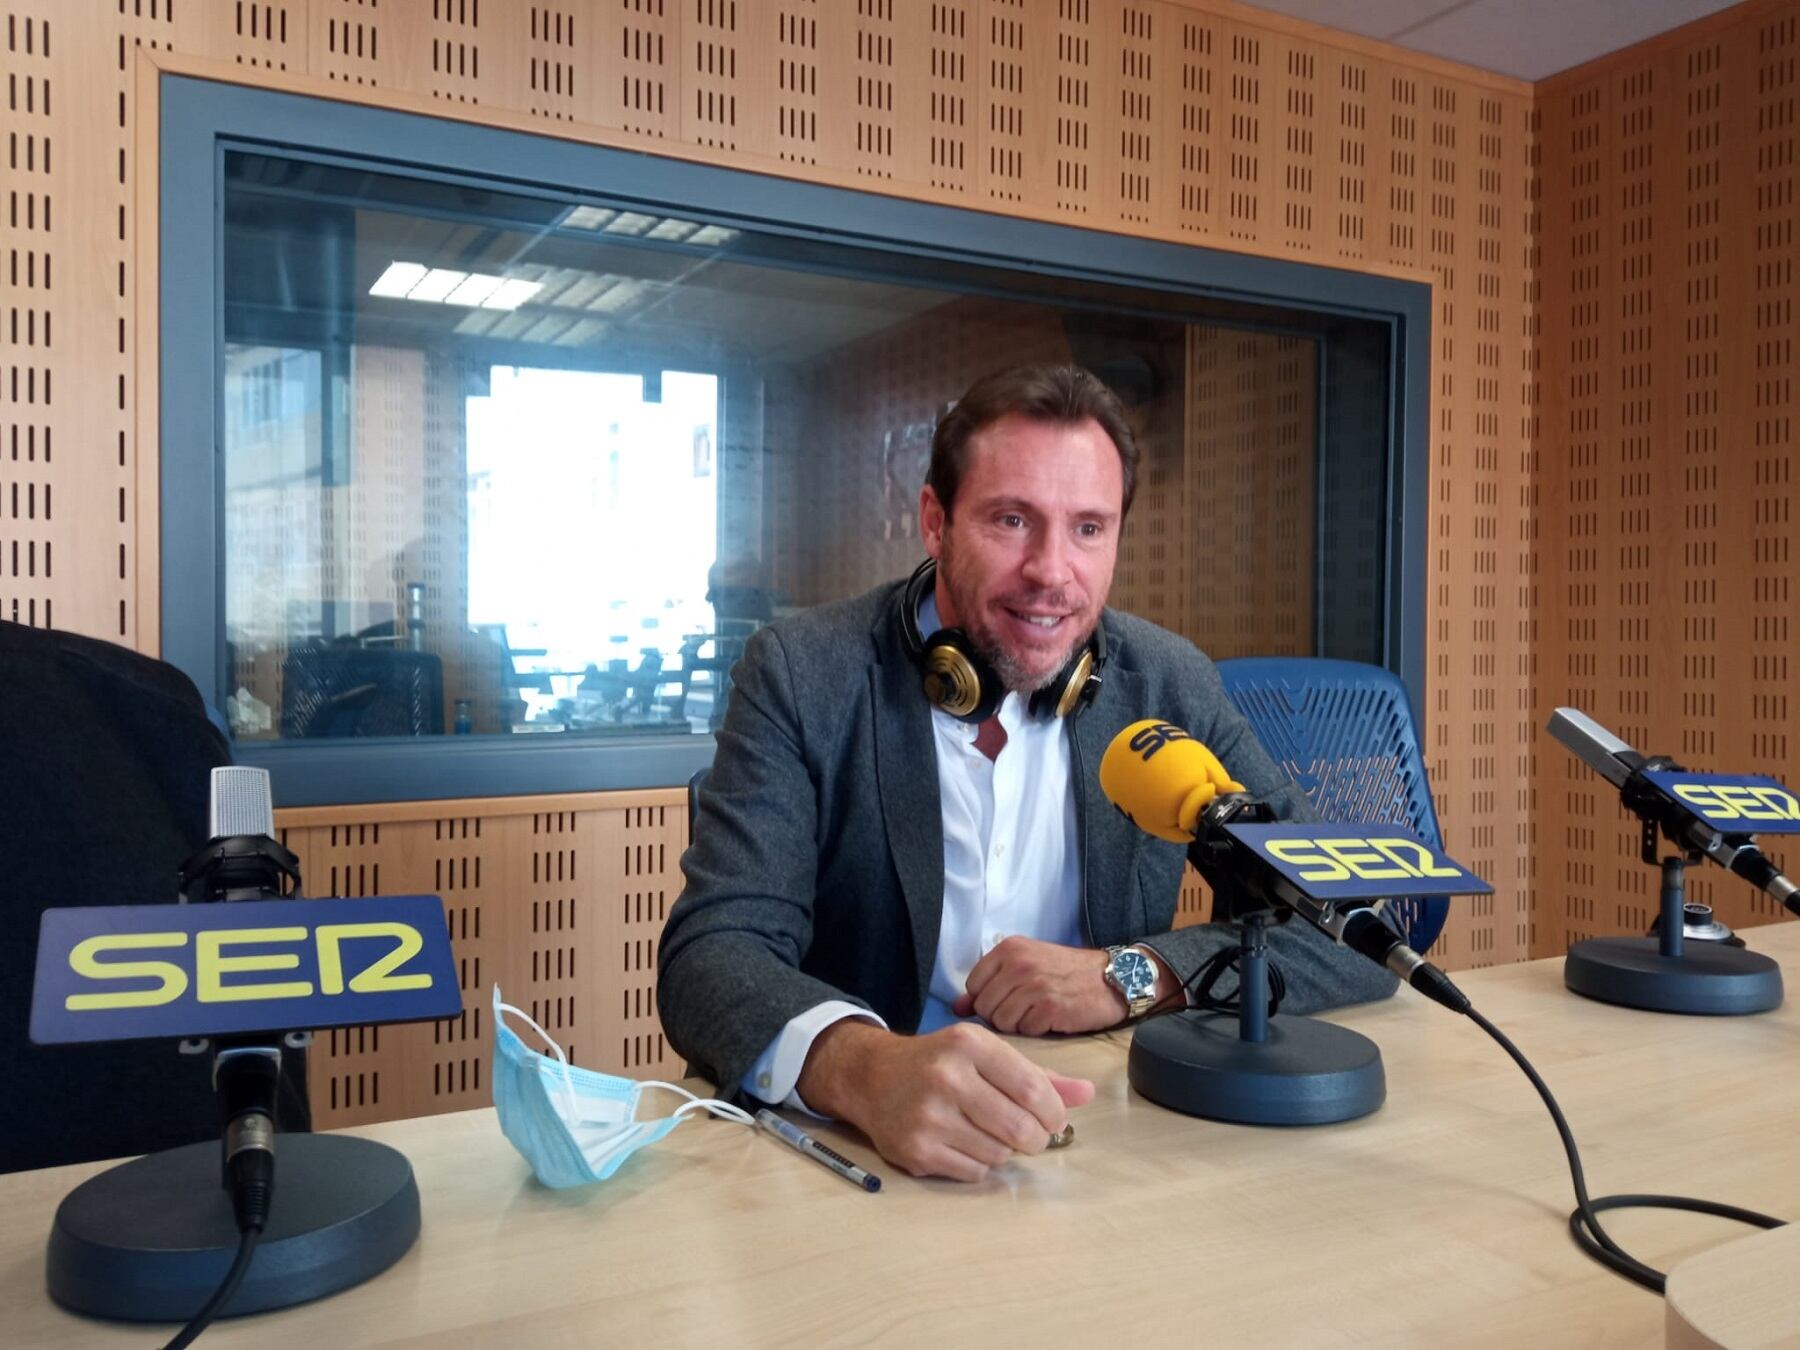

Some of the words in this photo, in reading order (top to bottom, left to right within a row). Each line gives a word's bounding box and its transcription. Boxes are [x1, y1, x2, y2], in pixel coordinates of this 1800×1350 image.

[1129, 724, 1190, 762] SE
[1265, 838, 1461, 881] SER
[65, 921, 433, 1010] SER
